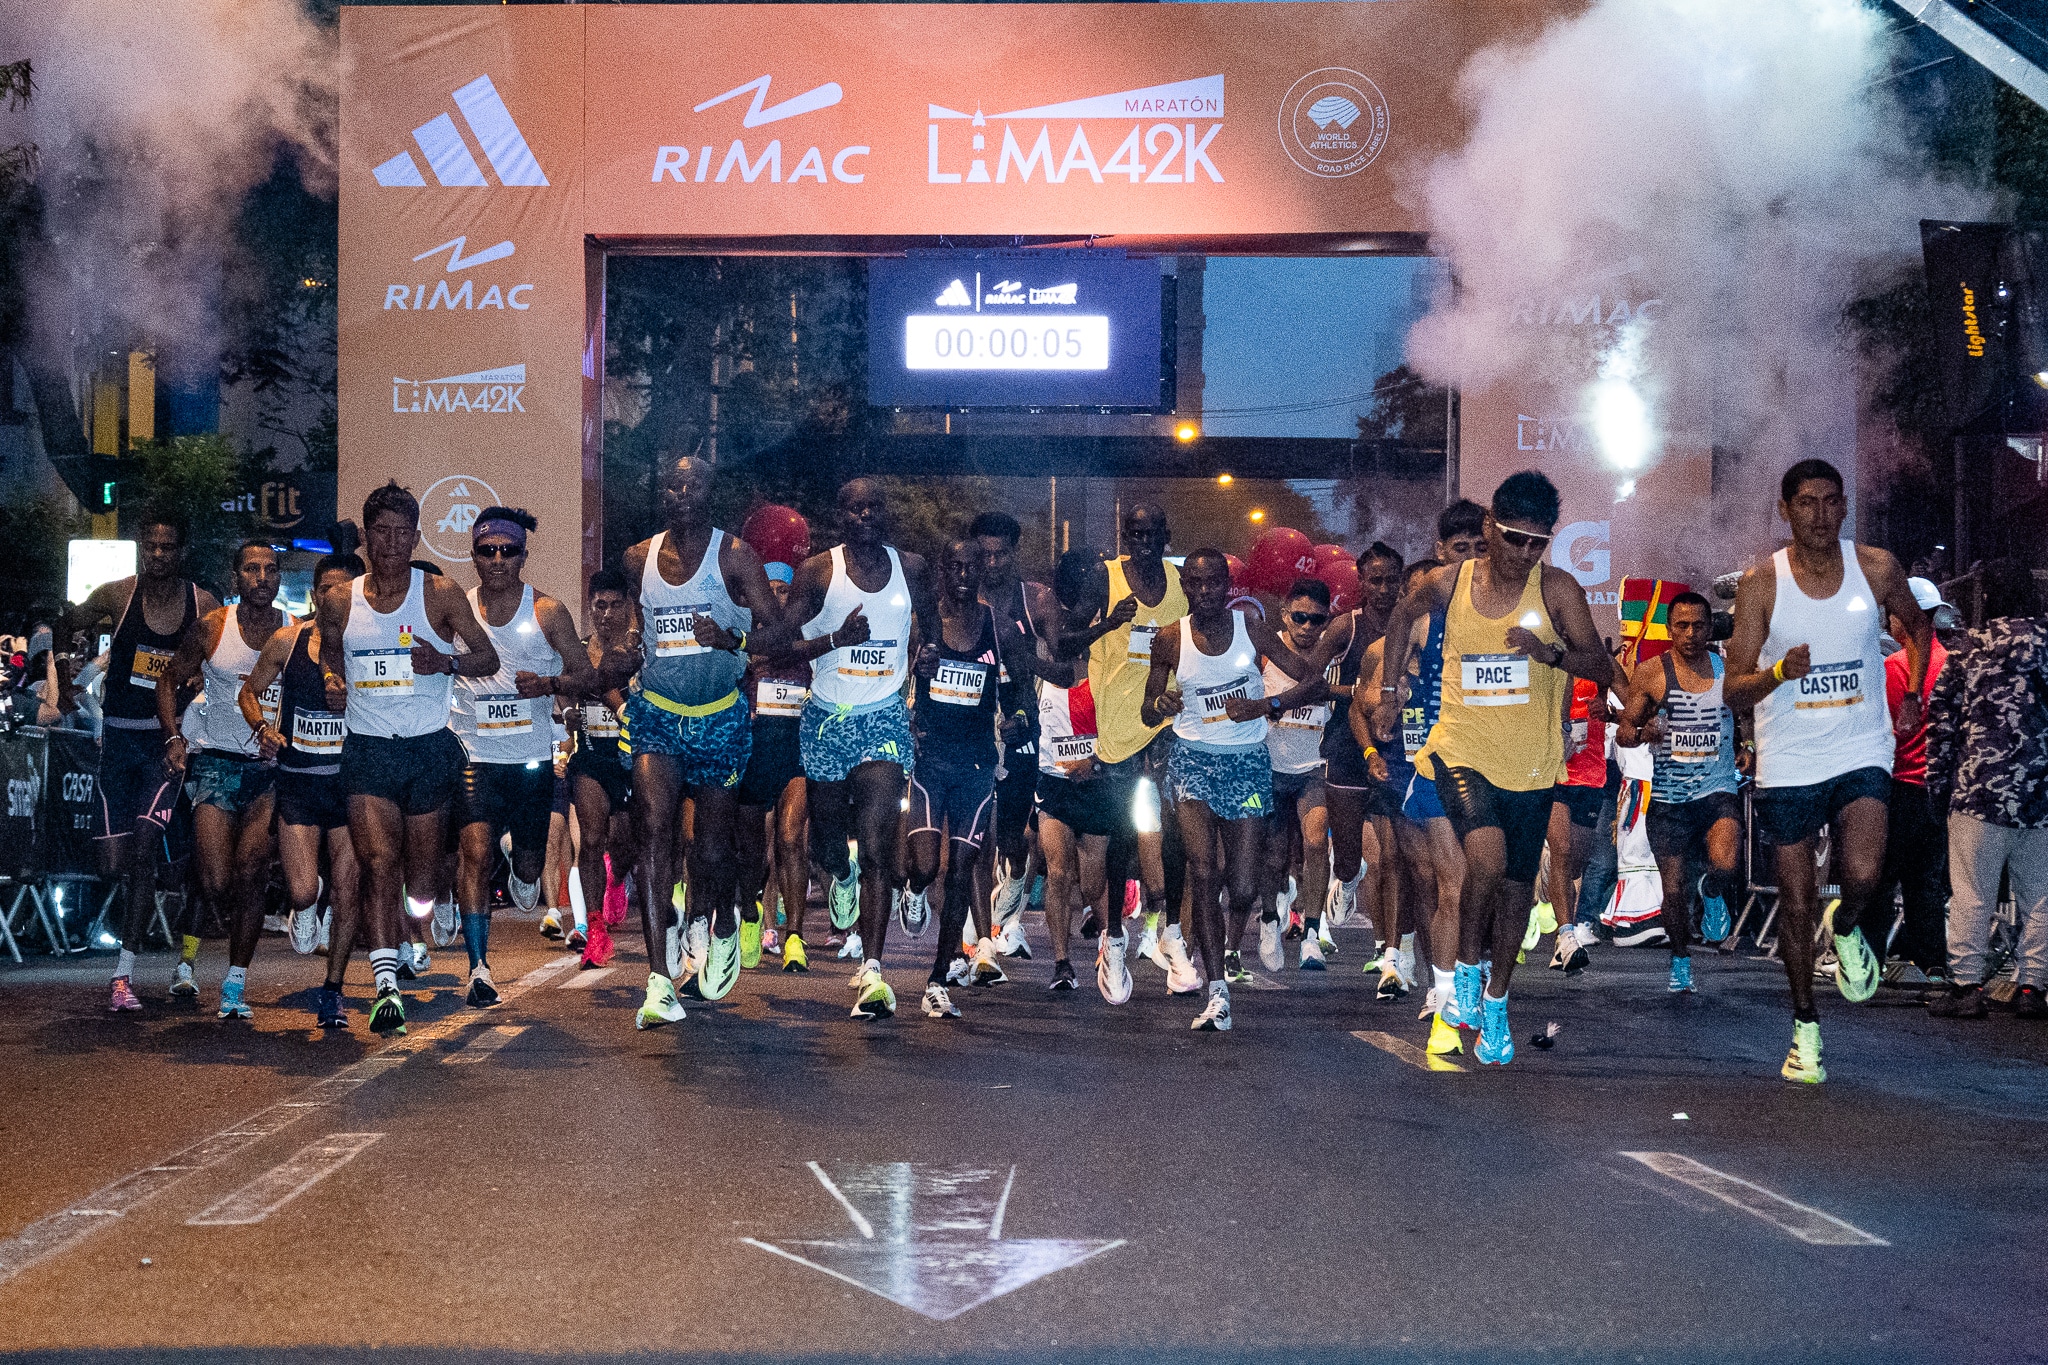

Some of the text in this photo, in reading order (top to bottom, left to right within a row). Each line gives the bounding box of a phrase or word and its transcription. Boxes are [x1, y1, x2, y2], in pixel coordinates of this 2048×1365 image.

[1124, 96, 1218, 112] MARATÓN
[1309, 141, 1358, 150] ATHLETICS
[1317, 133, 1350, 141] WORLD
[928, 122, 1226, 184] LIMA42K
[1316, 163, 1342, 173] ROAD
[1343, 155, 1366, 171] RACE
[1365, 131, 1383, 158] LABEL
[651, 139, 871, 184] RIMAC
[383, 279, 535, 311] RIMAC
[935, 328, 1082, 358] 00:00:05
[393, 384, 527, 413] LIMA42K
[655, 616, 696, 635] GESAB
[146, 656, 171, 674] 396
[850, 649, 886, 665] MOSE
[374, 660, 387, 676] 15
[1475, 665, 1512, 684] PACE
[1800, 672, 1859, 695] CASTRO
[776, 687, 788, 700] 57
[487, 703, 518, 719] PACE
[297, 718, 343, 737] MARTIN
[1057, 741, 1093, 757] RAMOS
[1675, 734, 1717, 747] PAUCAR
